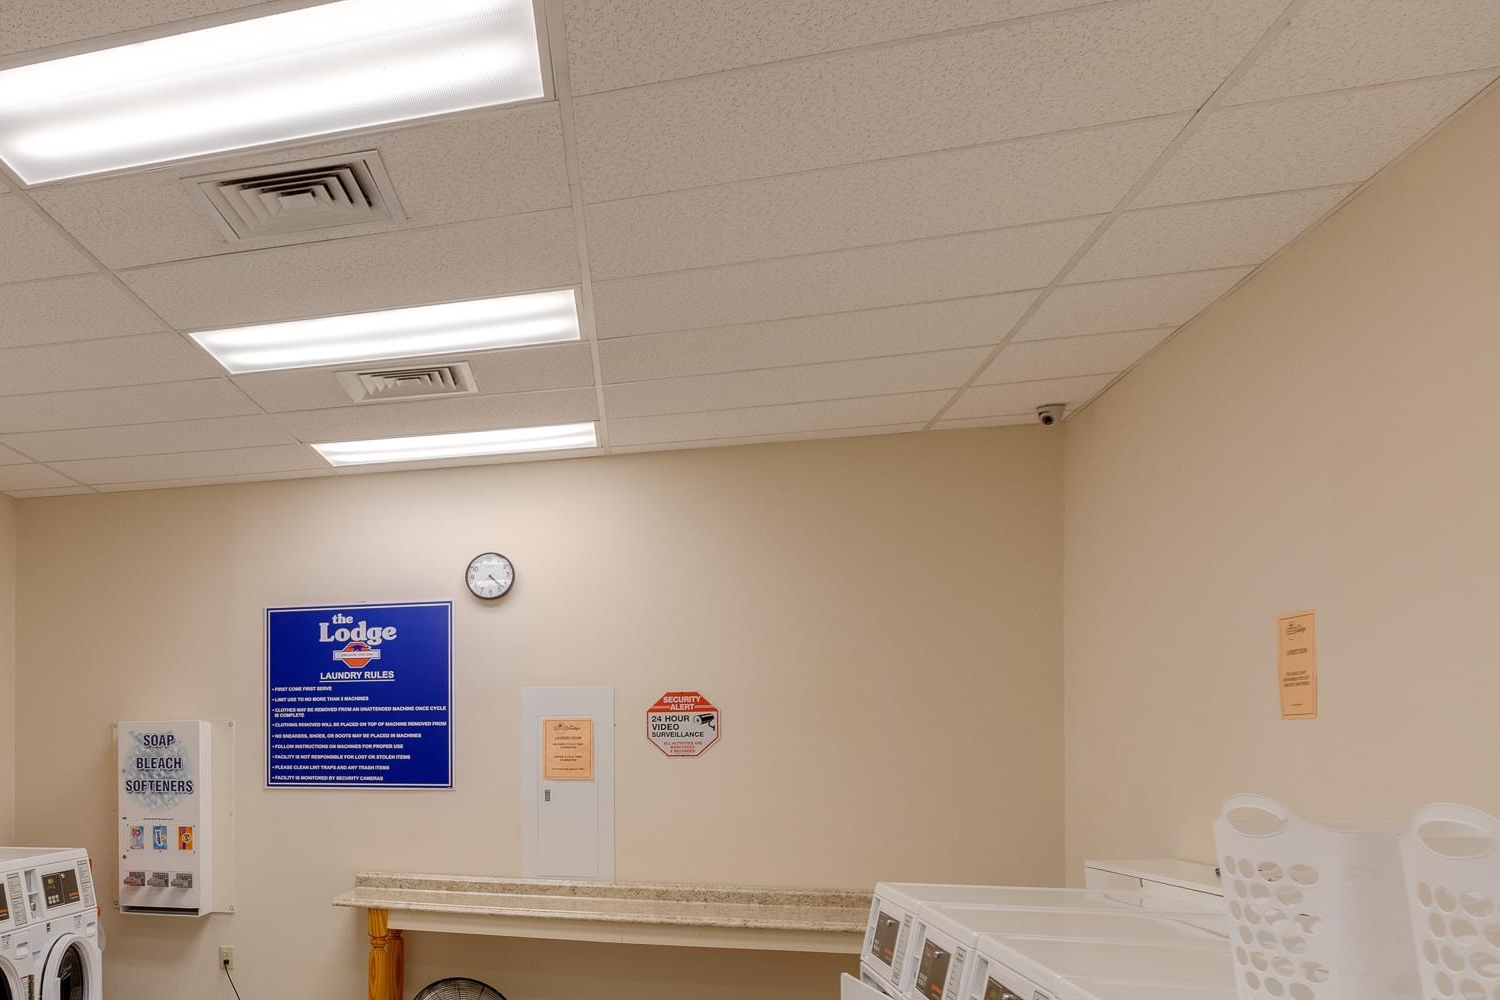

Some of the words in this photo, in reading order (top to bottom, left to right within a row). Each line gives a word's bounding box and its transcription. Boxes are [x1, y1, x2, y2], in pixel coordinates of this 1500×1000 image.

[332, 613, 353, 624] the
[319, 620, 397, 645] Lodge
[320, 672, 362, 680] LAUNDRY
[364, 671, 395, 679] RULES
[144, 735, 175, 746] SOAP
[136, 758, 182, 769] BLEACH
[126, 780, 193, 792] SOFTENERS
